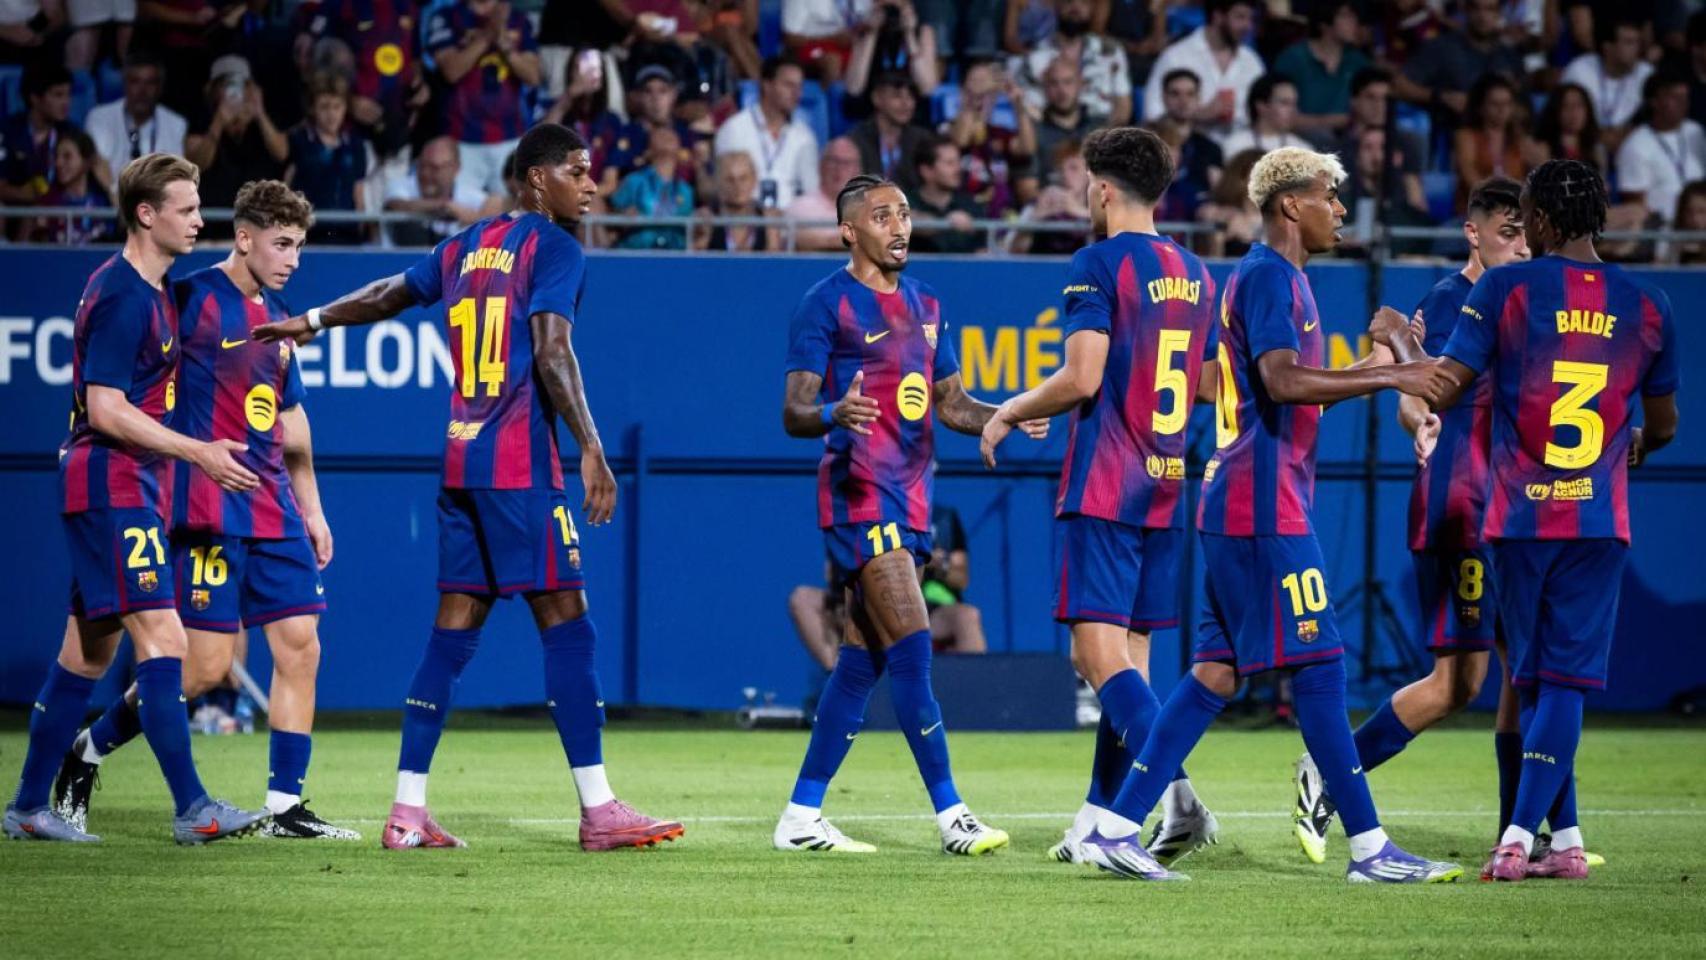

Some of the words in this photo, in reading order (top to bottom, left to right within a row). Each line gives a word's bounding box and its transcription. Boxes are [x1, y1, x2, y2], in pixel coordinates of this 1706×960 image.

[449, 296, 507, 398] 14
[1555, 309, 1617, 339] BALDE
[0, 316, 75, 385] FC
[961, 307, 1063, 391] MÉ
[1152, 329, 1192, 435] 5
[1544, 360, 1609, 470] 3
[123, 527, 166, 569] 21
[867, 522, 901, 557] 11
[190, 545, 228, 587] 16
[1459, 558, 1484, 601] 8
[1282, 567, 1328, 616] 10
